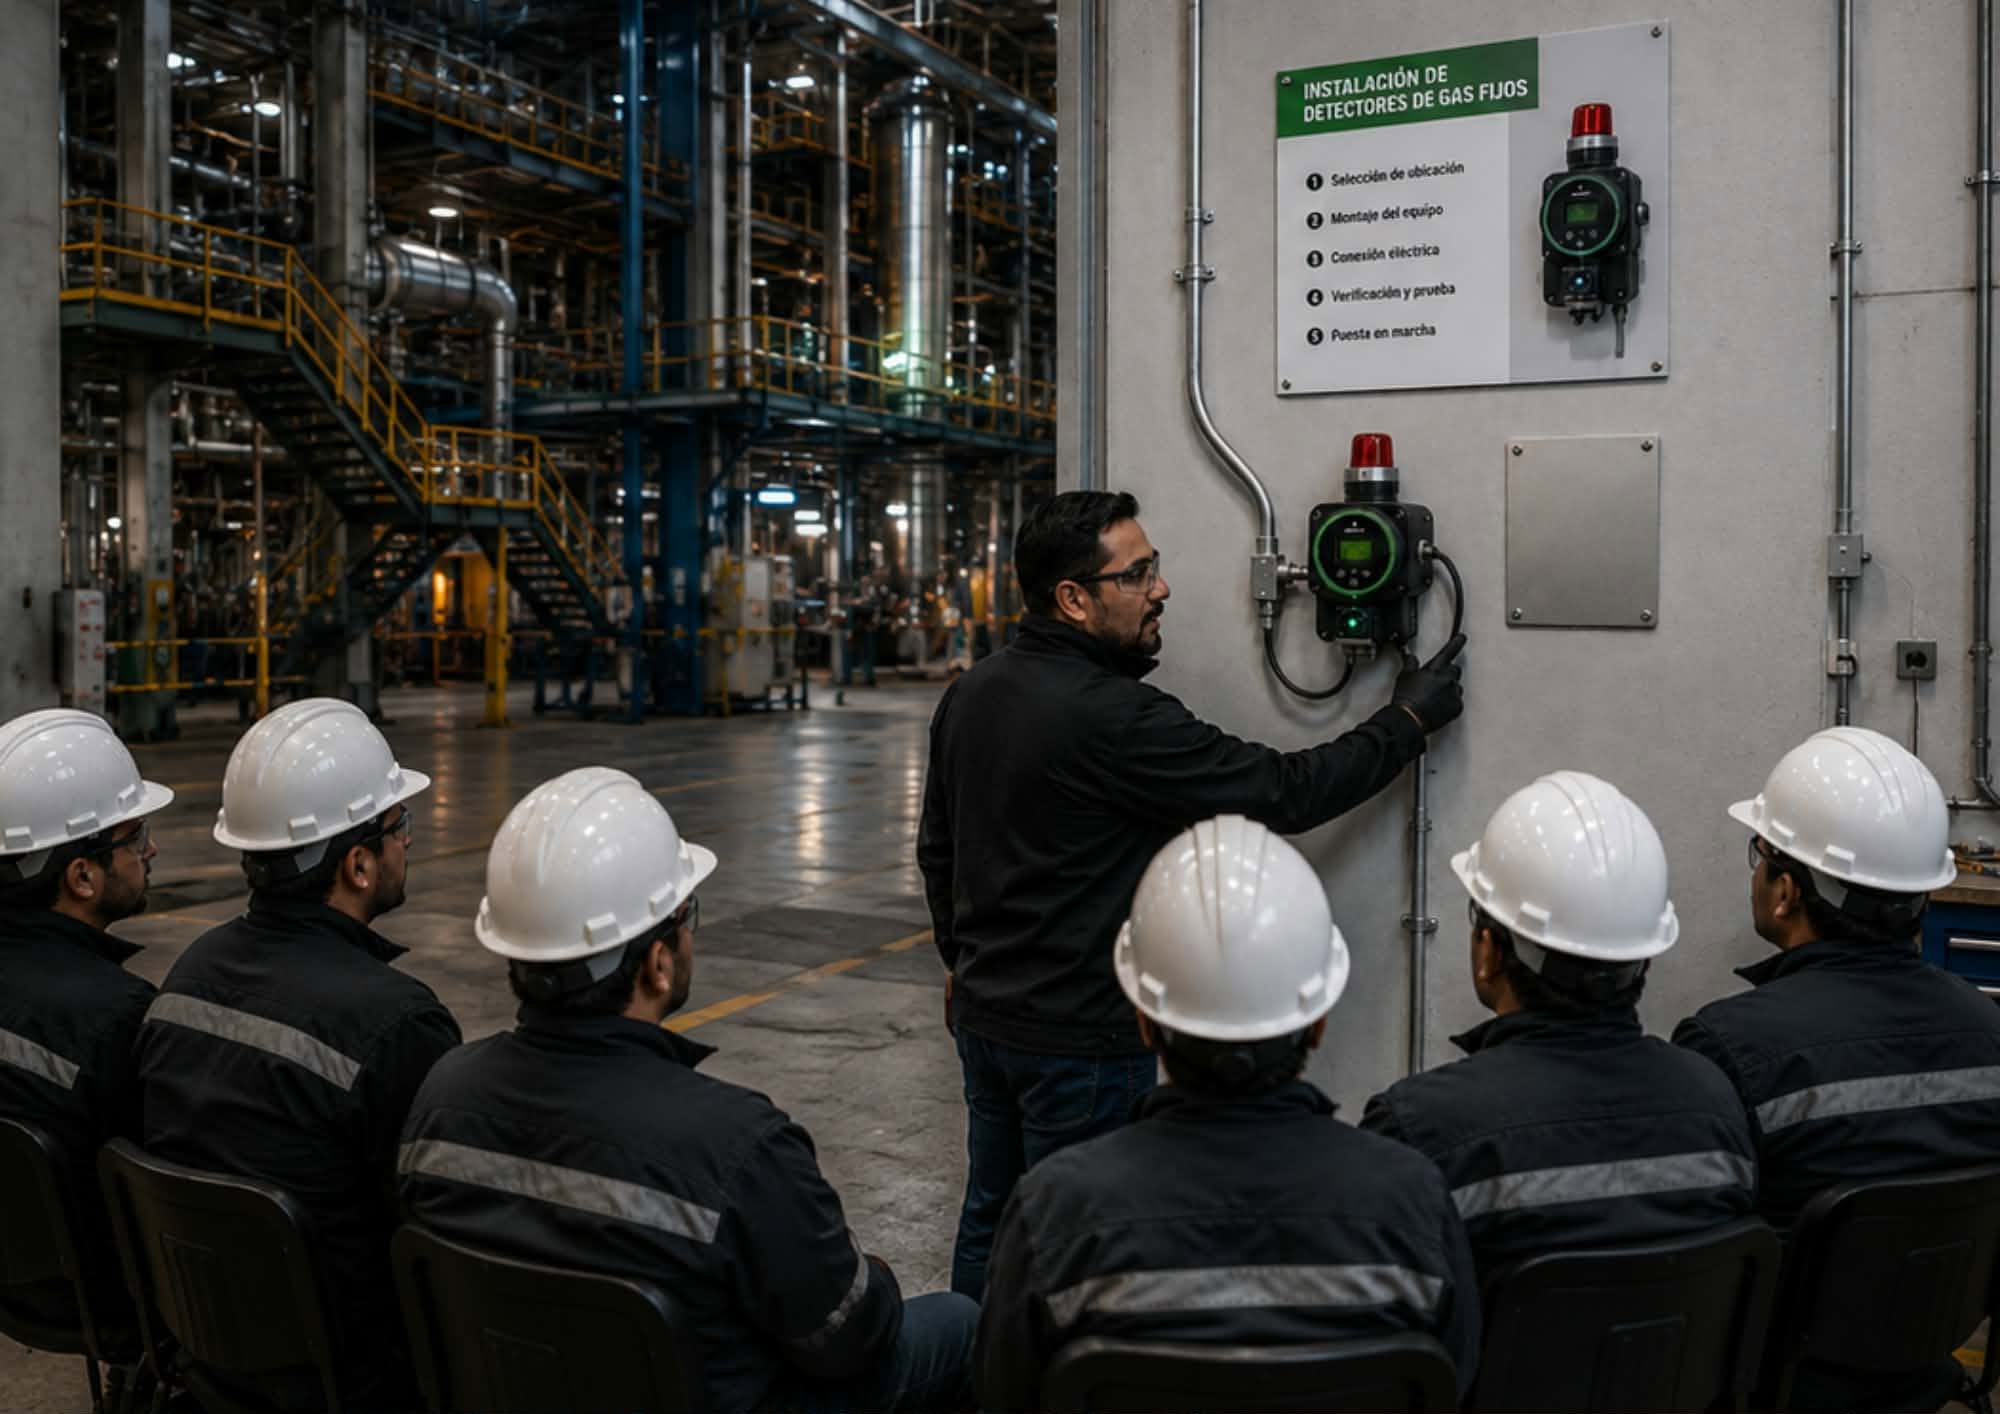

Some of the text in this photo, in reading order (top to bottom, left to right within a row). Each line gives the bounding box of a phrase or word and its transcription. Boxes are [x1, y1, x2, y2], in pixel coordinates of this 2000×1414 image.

[1304, 64, 1448, 100] INSTALACIÓN DE
[1304, 79, 1528, 123] DETECTORES DE GAS FIJOS
[1331, 169, 1387, 187] Selección
[1390, 168, 1405, 181] de
[1408, 161, 1465, 179] ubicación
[1331, 209, 1378, 225] Montaje
[1382, 206, 1400, 219] del
[1402, 203, 1444, 220] equipo
[1402, 287, 1411, 301] y
[1414, 282, 1456, 299] prueba
[1331, 327, 1370, 342] Puesta
[1374, 328, 1389, 339] en
[1392, 323, 1436, 338] marcha
